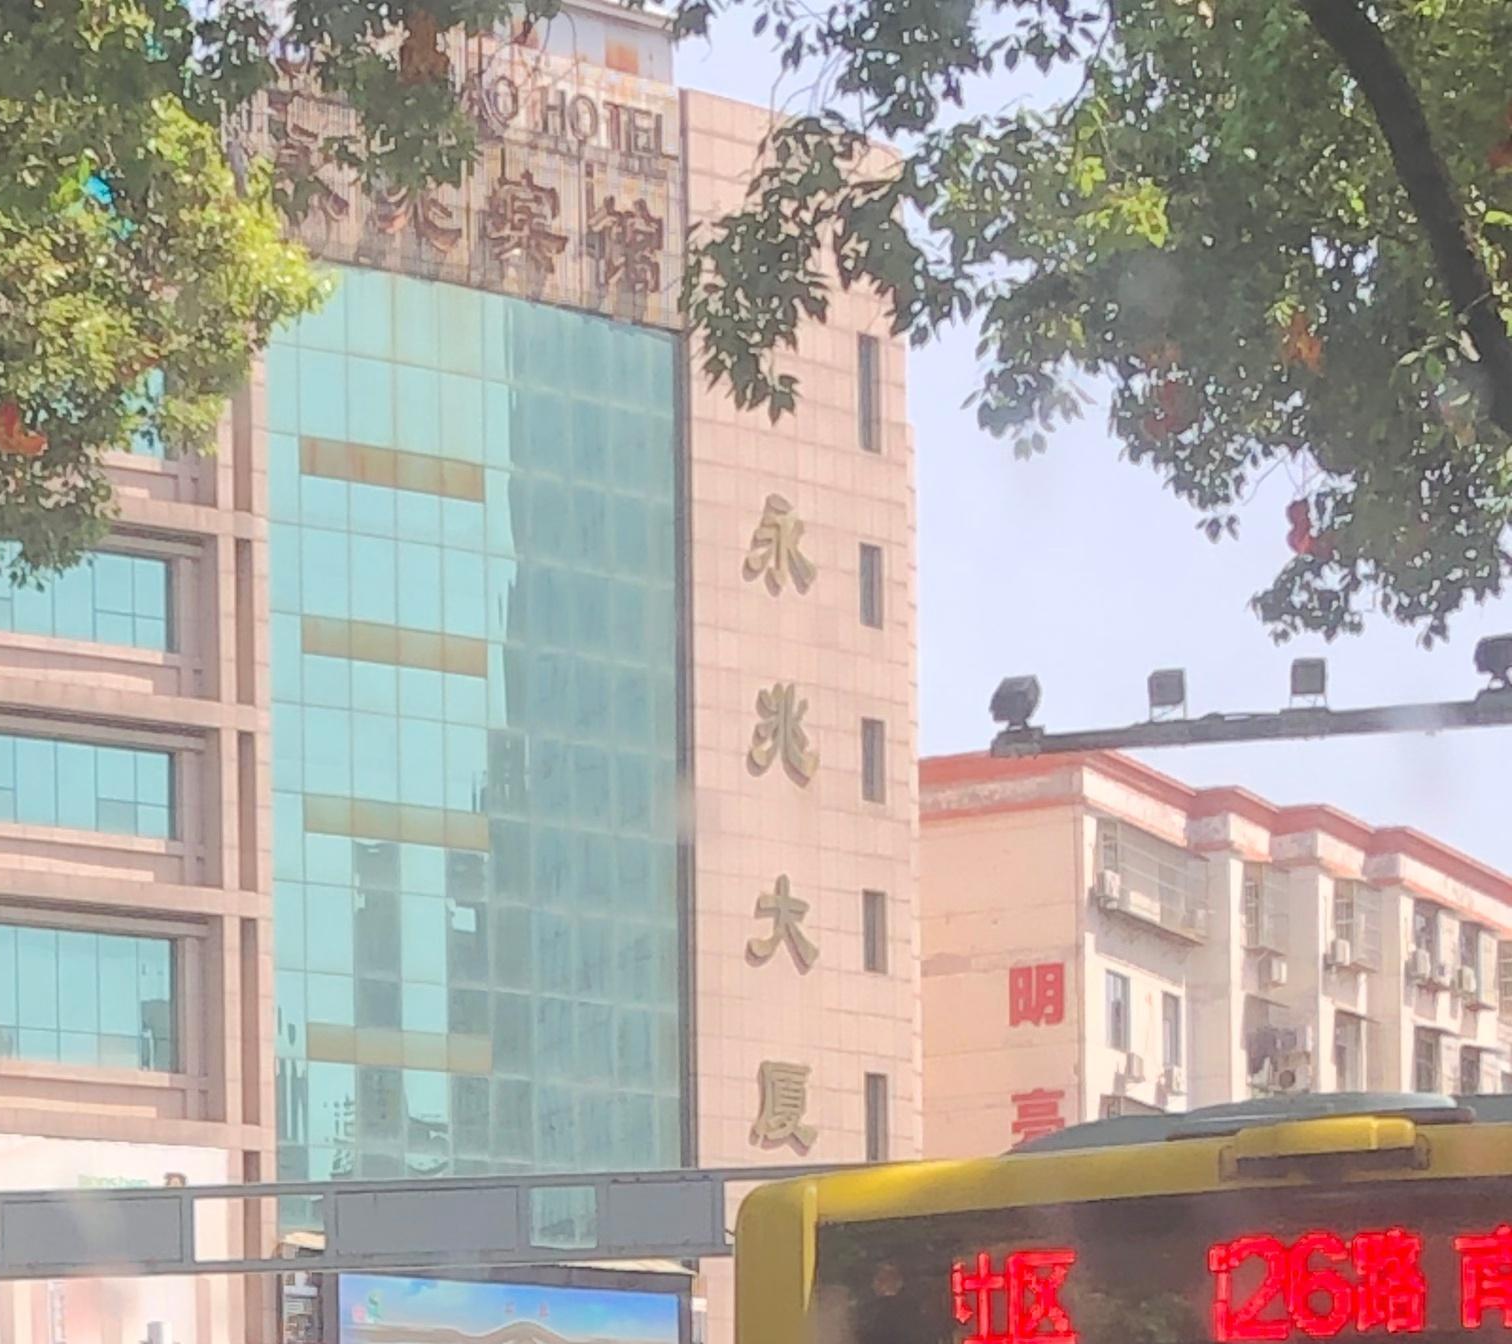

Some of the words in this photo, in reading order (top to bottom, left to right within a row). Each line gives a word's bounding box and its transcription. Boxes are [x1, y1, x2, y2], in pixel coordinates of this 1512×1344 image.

[540, 86, 679, 160] HOTEL
[741, 493, 820, 1159] 永兆大厦
